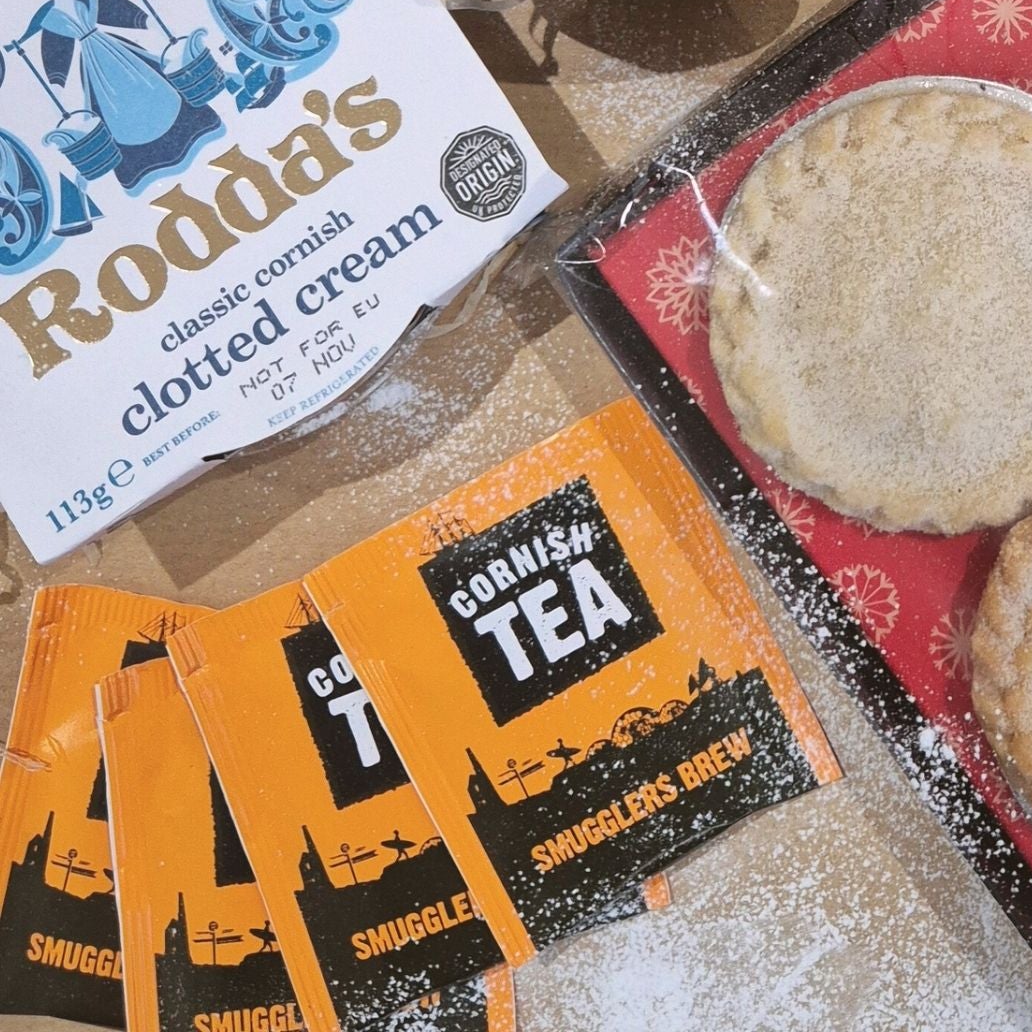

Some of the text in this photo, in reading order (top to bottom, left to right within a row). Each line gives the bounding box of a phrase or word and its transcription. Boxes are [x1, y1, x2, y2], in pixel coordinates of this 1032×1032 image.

[449, 139, 502, 182] DESIGNATED
[455, 148, 516, 202] ORIGIN
[0, 74, 402, 382] Rodda's
[121, 203, 444, 437] clotted cream
[160, 209, 355, 353] classic cornish
[238, 293, 381, 399] NOT FOR EU
[267, 344, 381, 429] KEEP REFRIGERATED
[270, 332, 357, 402] 07 NOV
[141, 410, 222, 468] BEST BEFORE:
[45, 479, 115, 533] 113g
[449, 521, 597, 620] CORNISH
[473, 557, 633, 683] TEA
[530, 727, 754, 873] SMUGGLERS BREW
